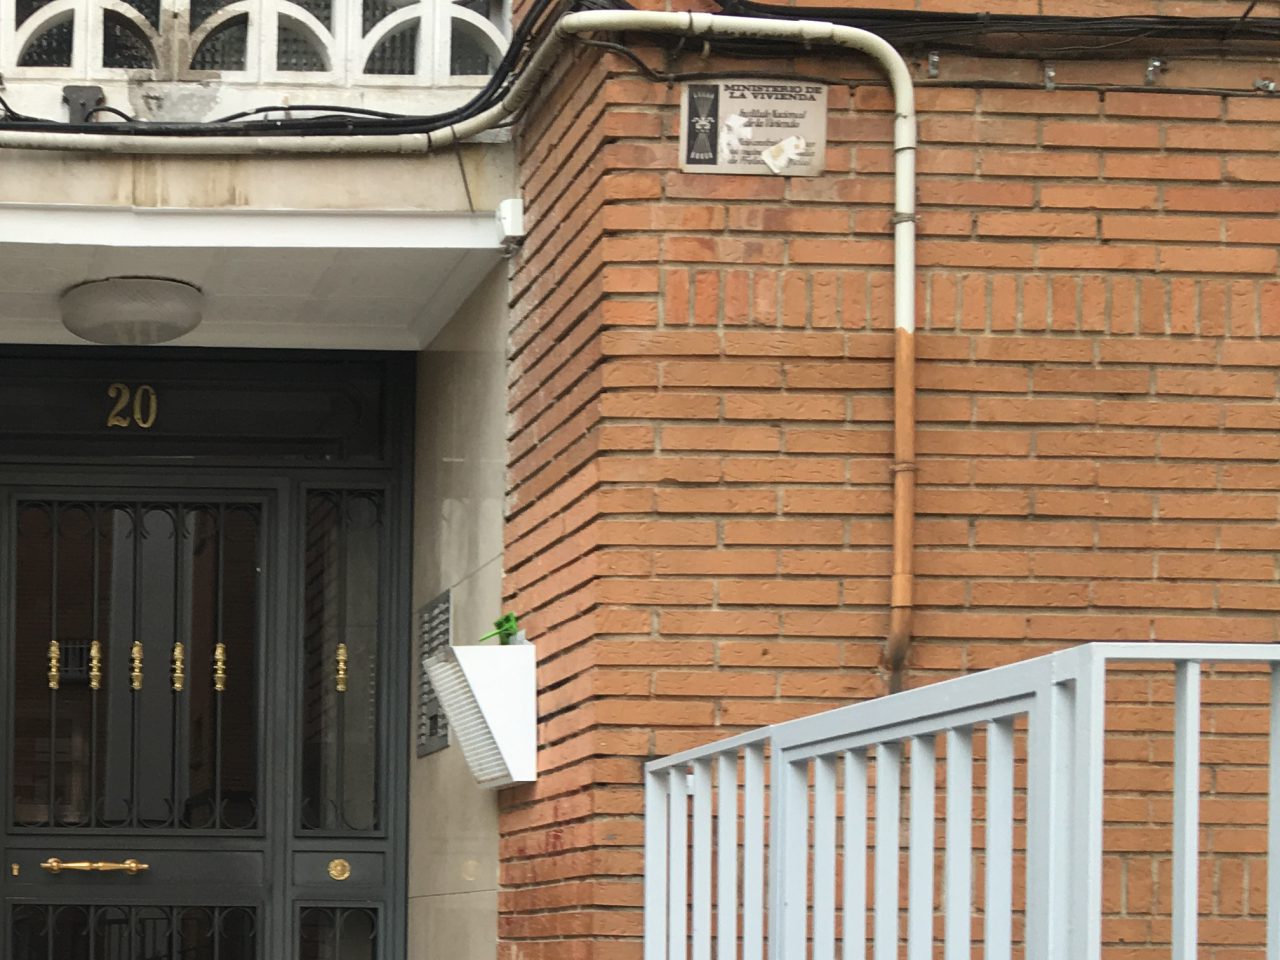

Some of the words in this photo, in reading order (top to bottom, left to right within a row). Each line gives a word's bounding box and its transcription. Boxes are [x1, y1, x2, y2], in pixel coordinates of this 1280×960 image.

[723, 84, 802, 93] MINISTERIO
[805, 86, 822, 94] DE
[751, 92, 817, 101] VIVIENDA
[106, 383, 157, 428] 20
